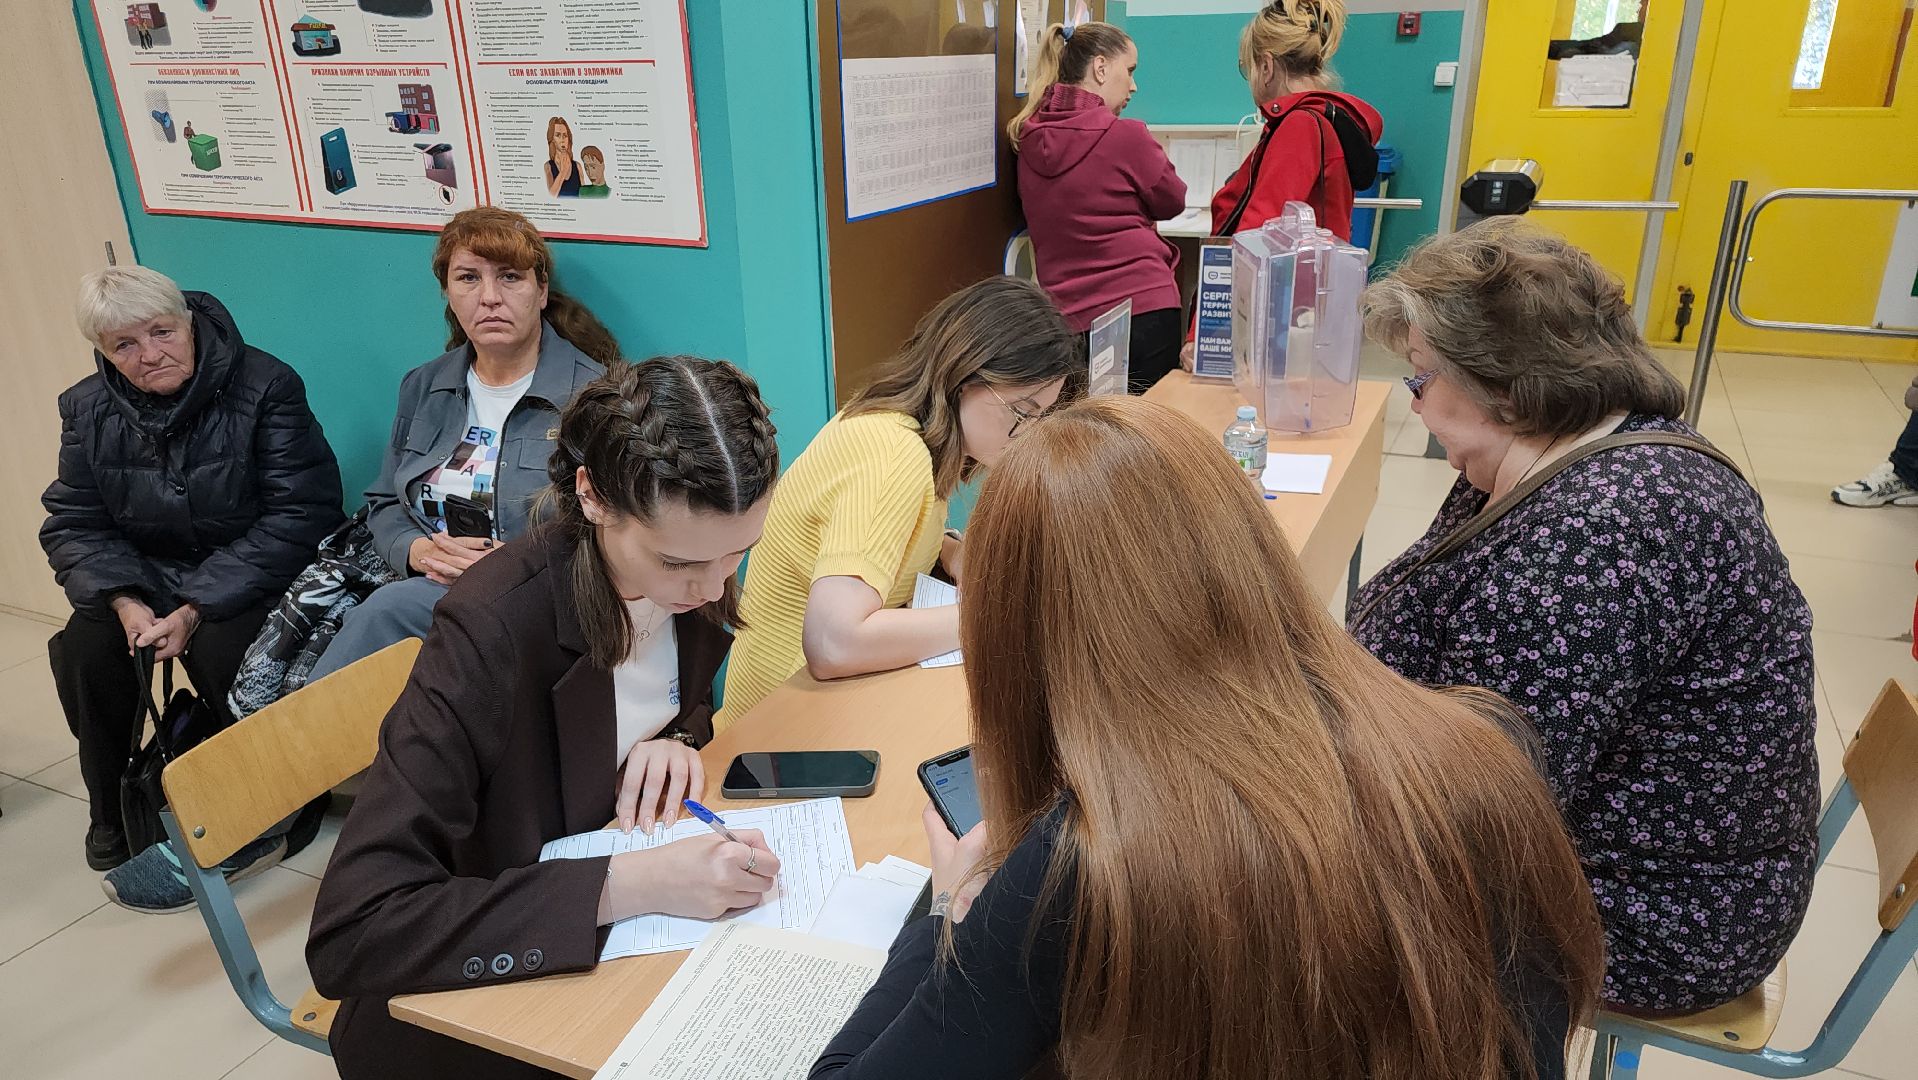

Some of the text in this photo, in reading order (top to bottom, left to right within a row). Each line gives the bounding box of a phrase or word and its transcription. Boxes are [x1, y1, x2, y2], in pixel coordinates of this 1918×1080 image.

[508, 68, 524, 77] ЕСЛИ
[526, 68, 538, 77] ВАС
[540, 67, 576, 76] ЗАХВАТИЛИ
[584, 67, 623, 76] ЗАЛОЖНИКИ
